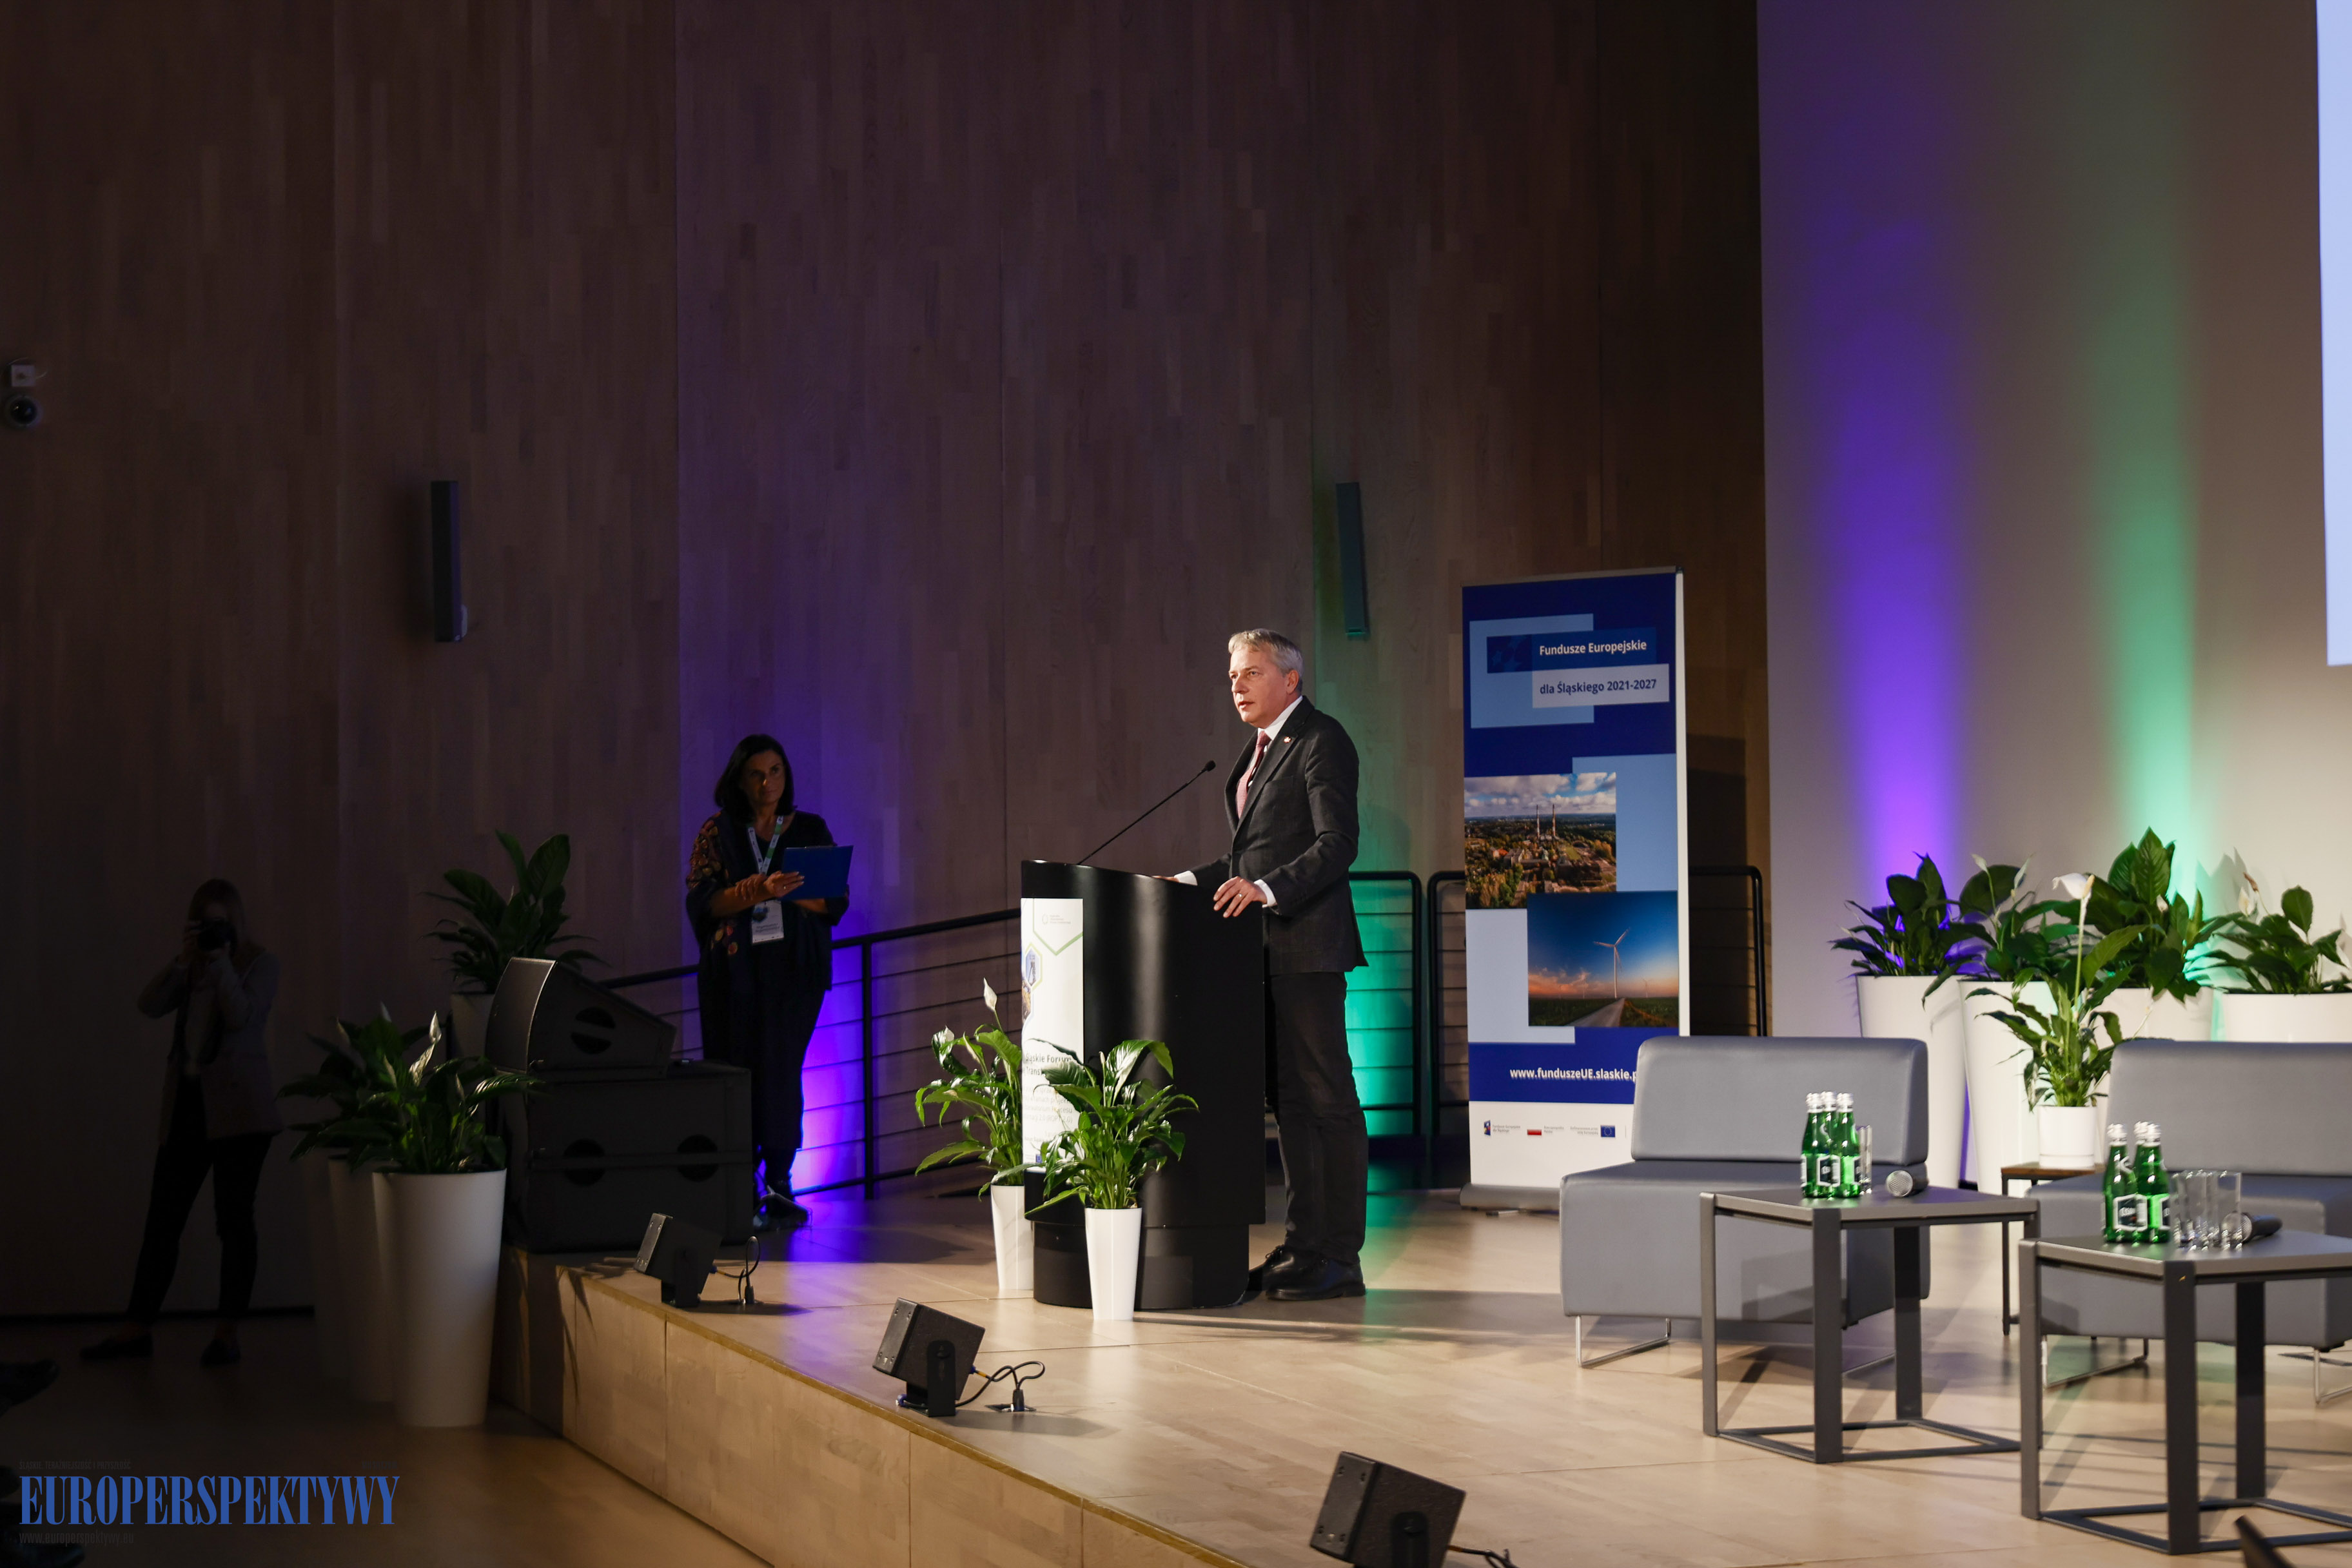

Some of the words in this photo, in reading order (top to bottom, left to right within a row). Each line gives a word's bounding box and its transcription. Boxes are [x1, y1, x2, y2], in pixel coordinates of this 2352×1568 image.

[1540, 643, 1585, 656] Fundusze
[1589, 640, 1647, 655] Europejskie
[1540, 683, 1554, 694] dla
[1557, 681, 1605, 696] Śląskiego
[1607, 679, 1656, 691] 2021-2027
[1510, 1067, 1638, 1084] www.funduszeUE.slaskie.p
